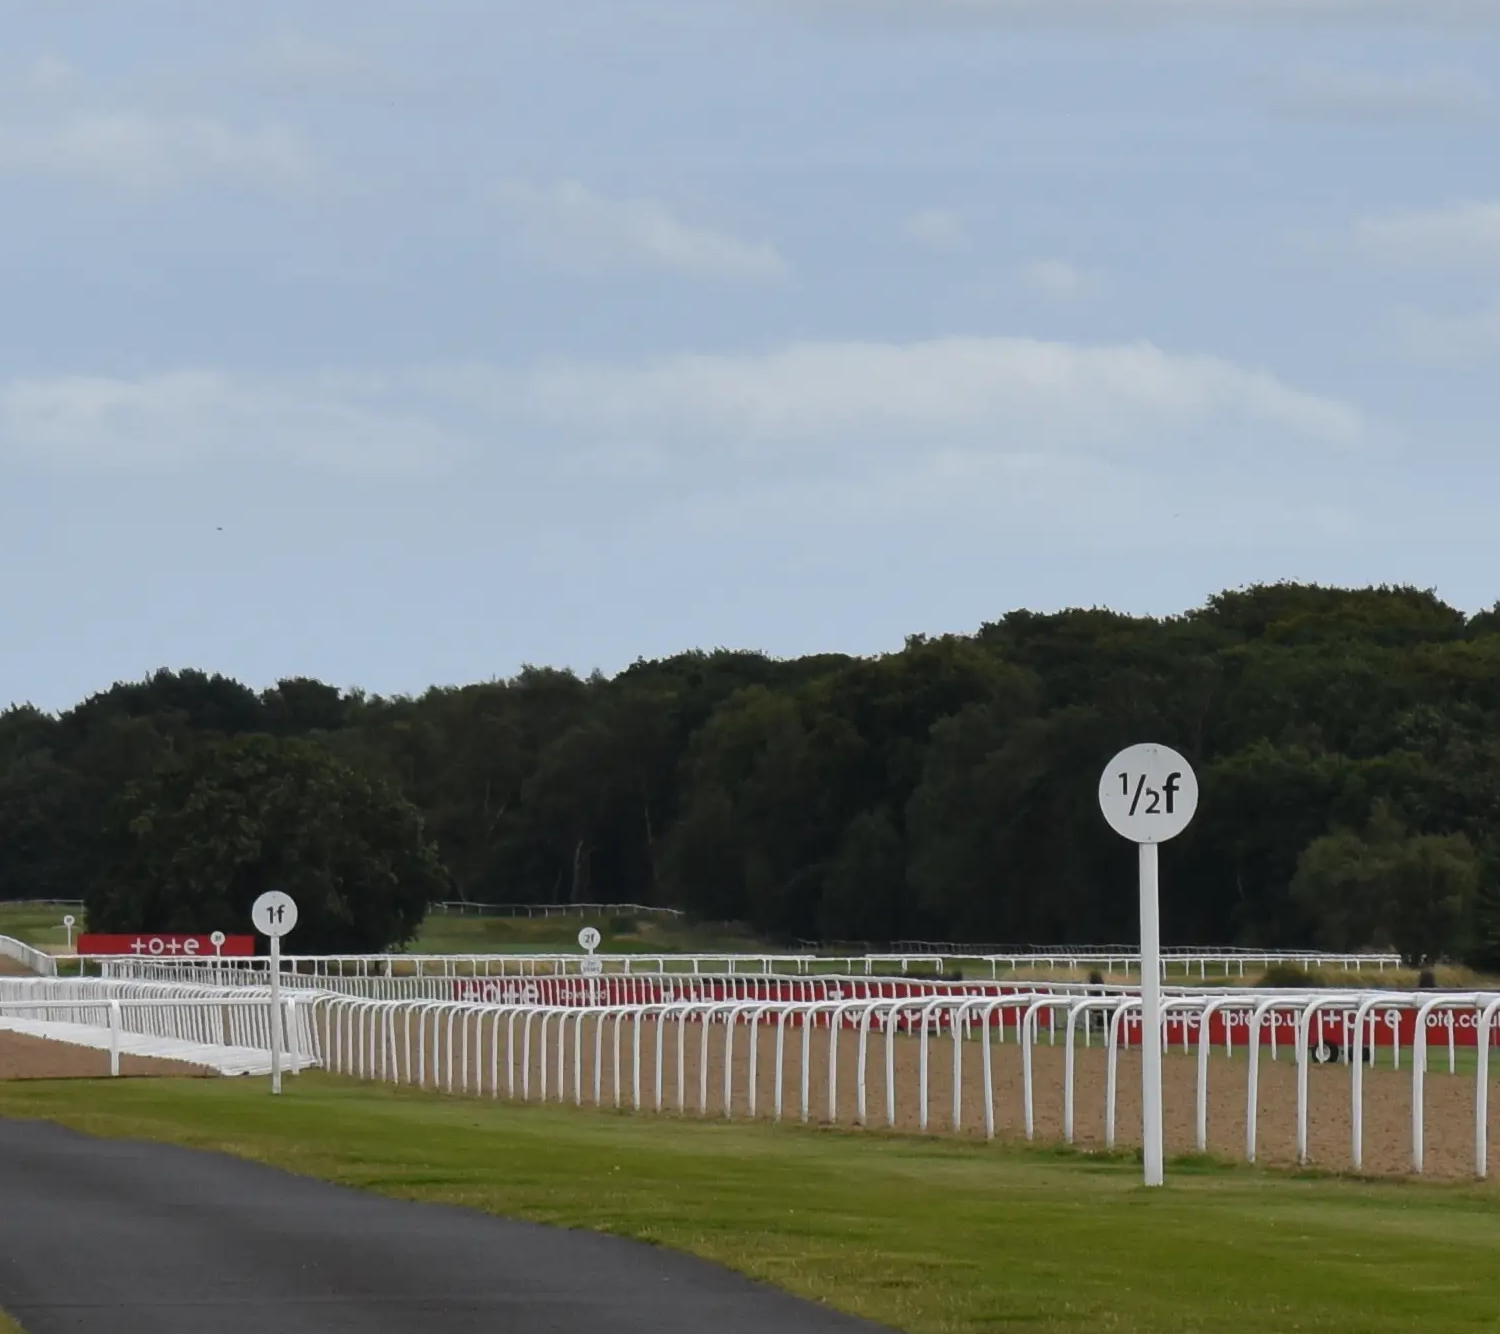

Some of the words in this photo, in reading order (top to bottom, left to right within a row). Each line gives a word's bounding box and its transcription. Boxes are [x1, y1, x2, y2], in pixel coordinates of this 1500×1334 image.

[266, 904, 286, 924] 1f
[130, 937, 200, 955] tote
[1126, 1010, 1203, 1028] tte
